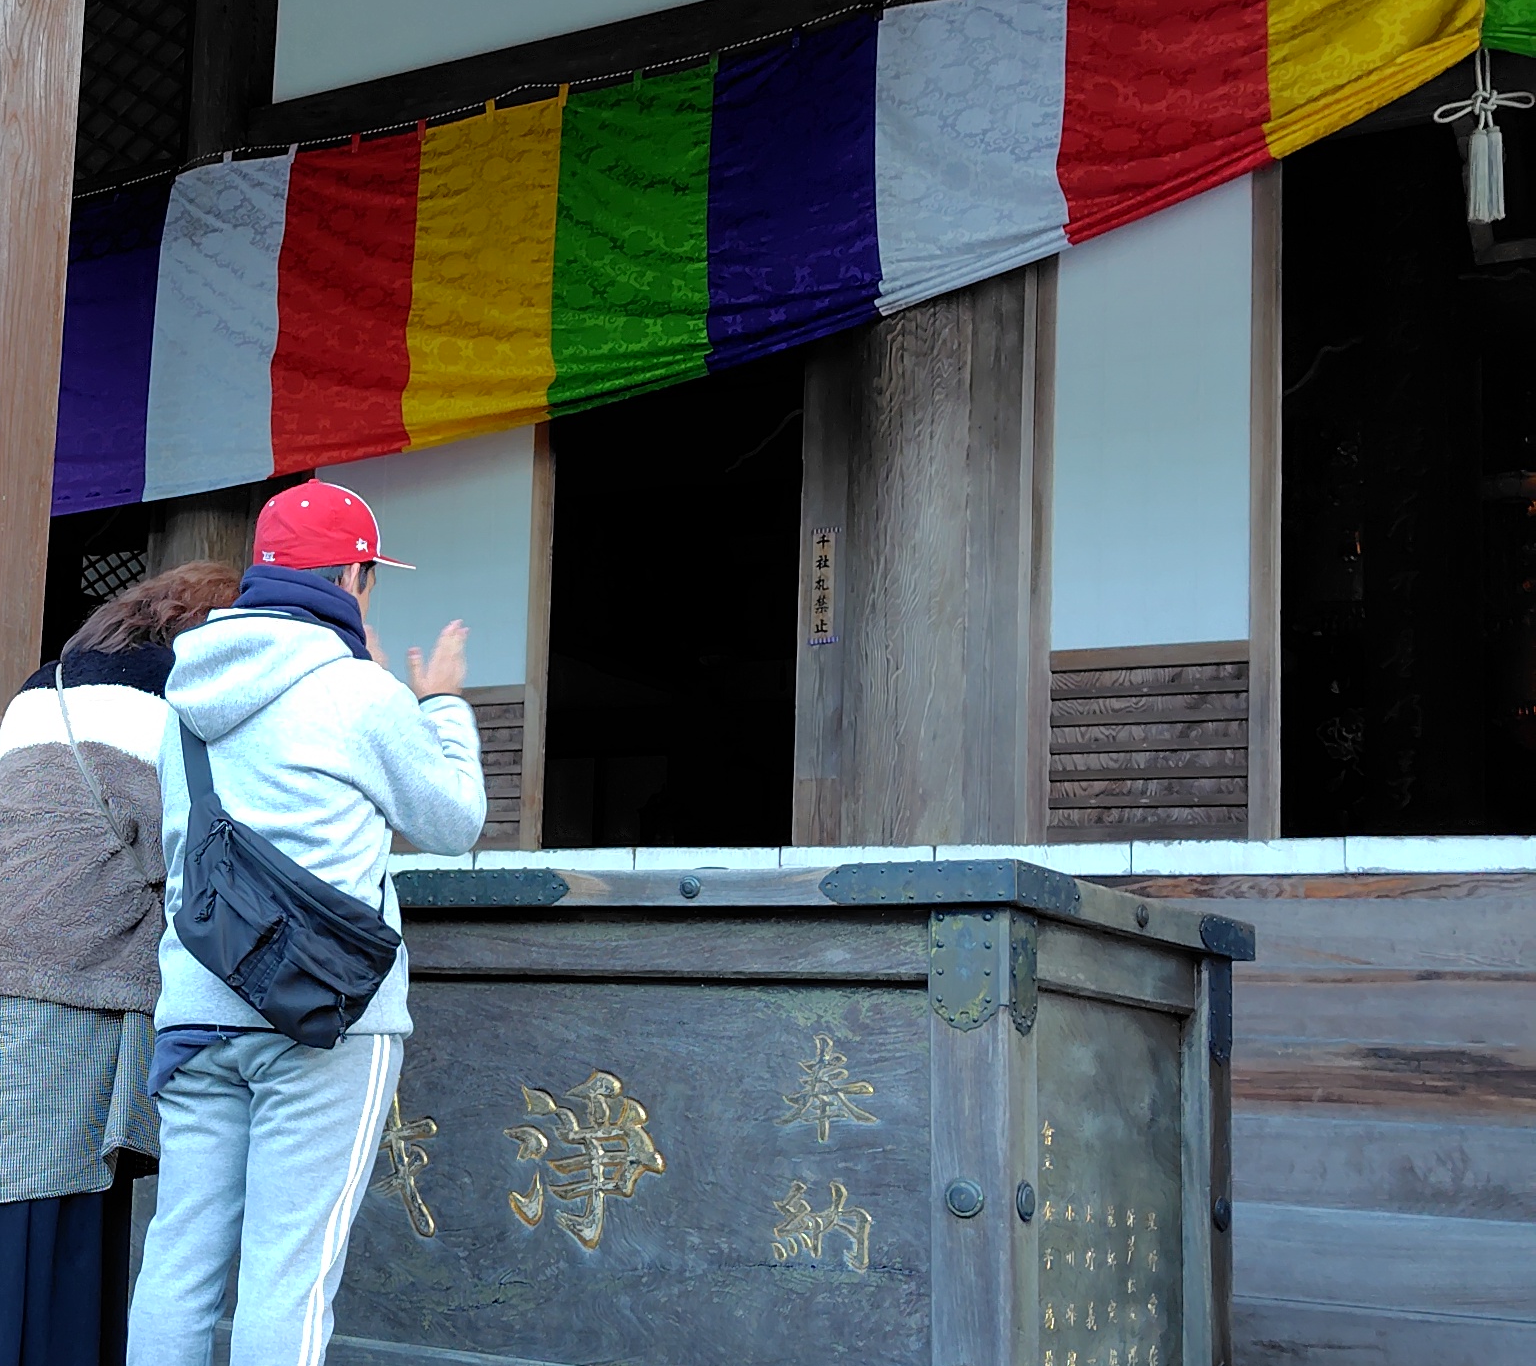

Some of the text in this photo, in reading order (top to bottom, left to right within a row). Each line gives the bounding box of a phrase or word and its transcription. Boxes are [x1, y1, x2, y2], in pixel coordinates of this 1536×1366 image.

[814, 534, 831, 634] 千社札禁止
[772, 1034, 877, 1273] 奉納
